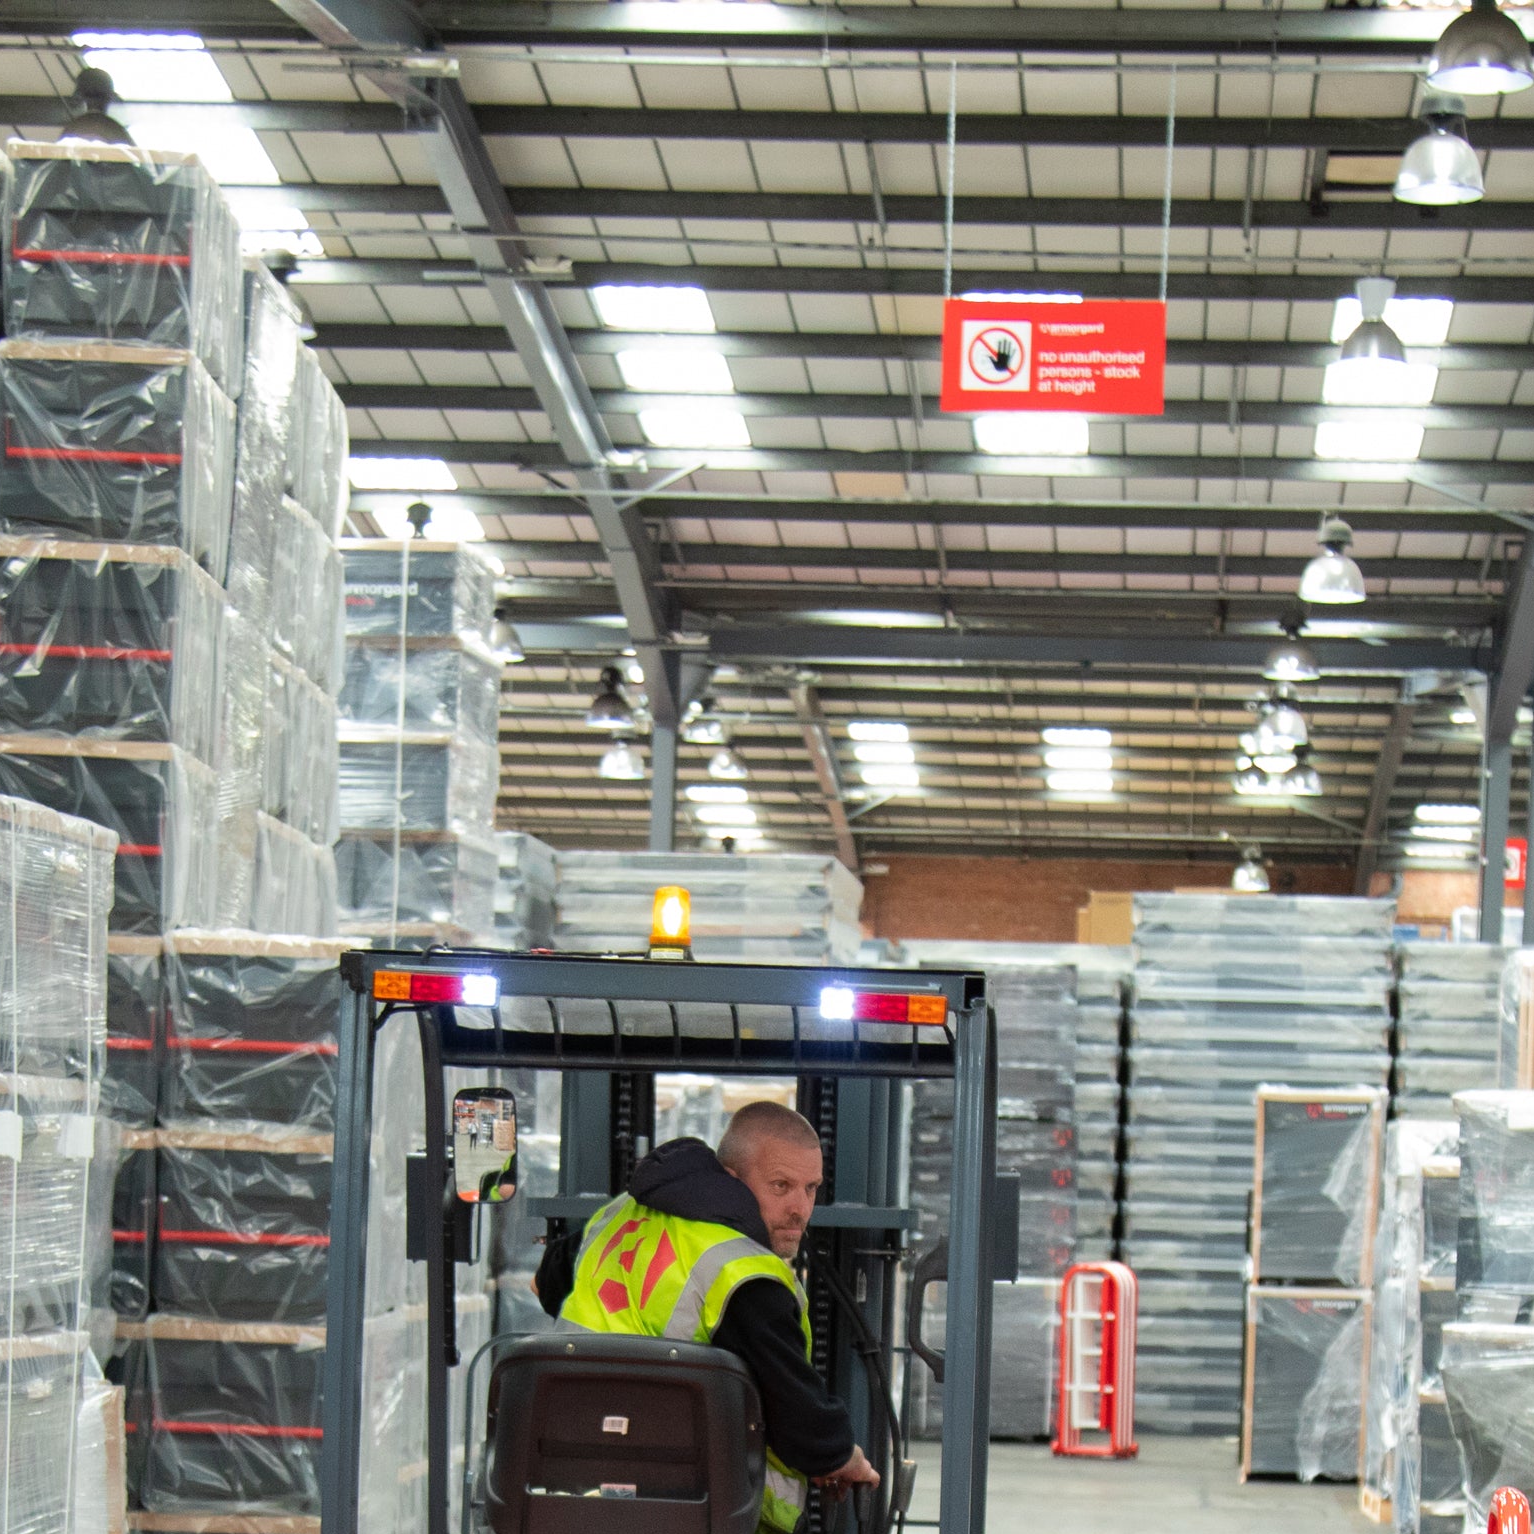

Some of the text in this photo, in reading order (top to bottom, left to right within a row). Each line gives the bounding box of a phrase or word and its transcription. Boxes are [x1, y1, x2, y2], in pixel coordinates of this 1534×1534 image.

[1051, 324, 1104, 335] armorgard
[1039, 350, 1145, 364] no unauthorised
[1038, 367, 1092, 380] persons
[1104, 366, 1141, 379] stock
[1038, 380, 1096, 395] at height
